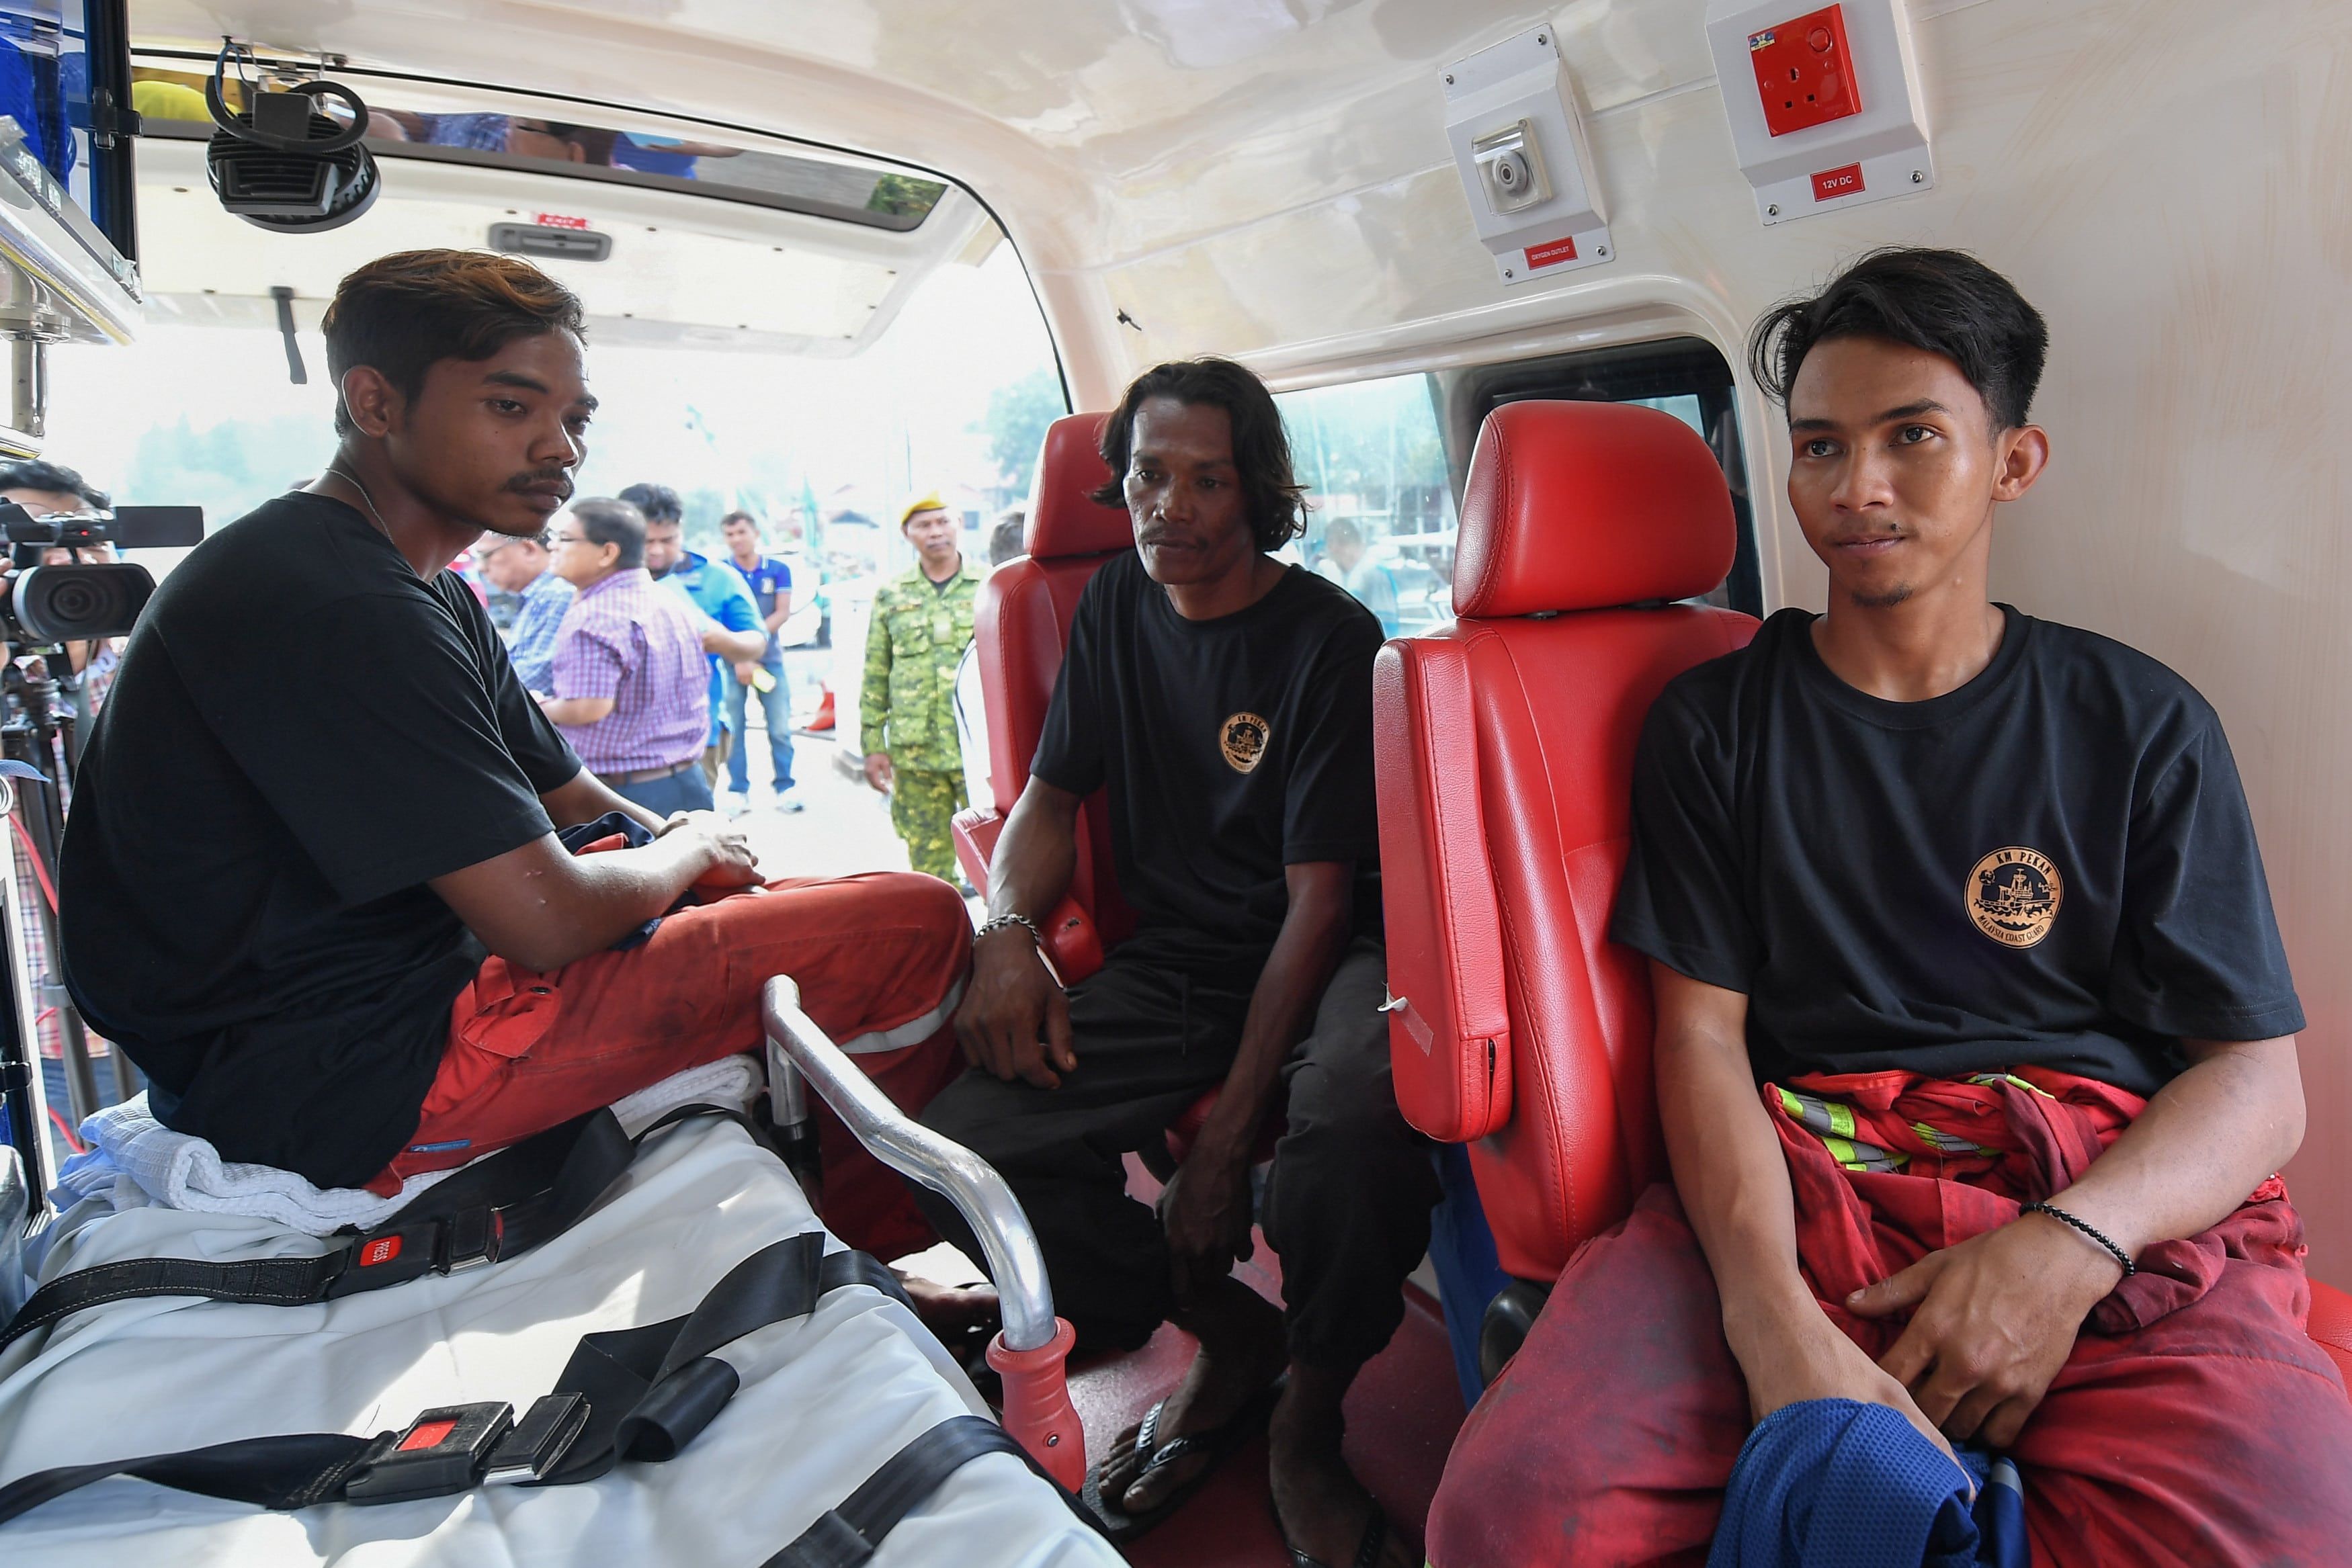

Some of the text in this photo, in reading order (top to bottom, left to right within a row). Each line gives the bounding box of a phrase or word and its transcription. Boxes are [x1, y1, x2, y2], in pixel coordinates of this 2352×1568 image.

[1822, 175, 1853, 189] 12V DC
[1531, 246, 1569, 261] OXYGEN OUTLET
[1997, 851, 2052, 875] KM PEKAN
[1977, 914, 2044, 943] MALAYSIA COAST GUARD
[372, 1241, 390, 1262] PRESS
